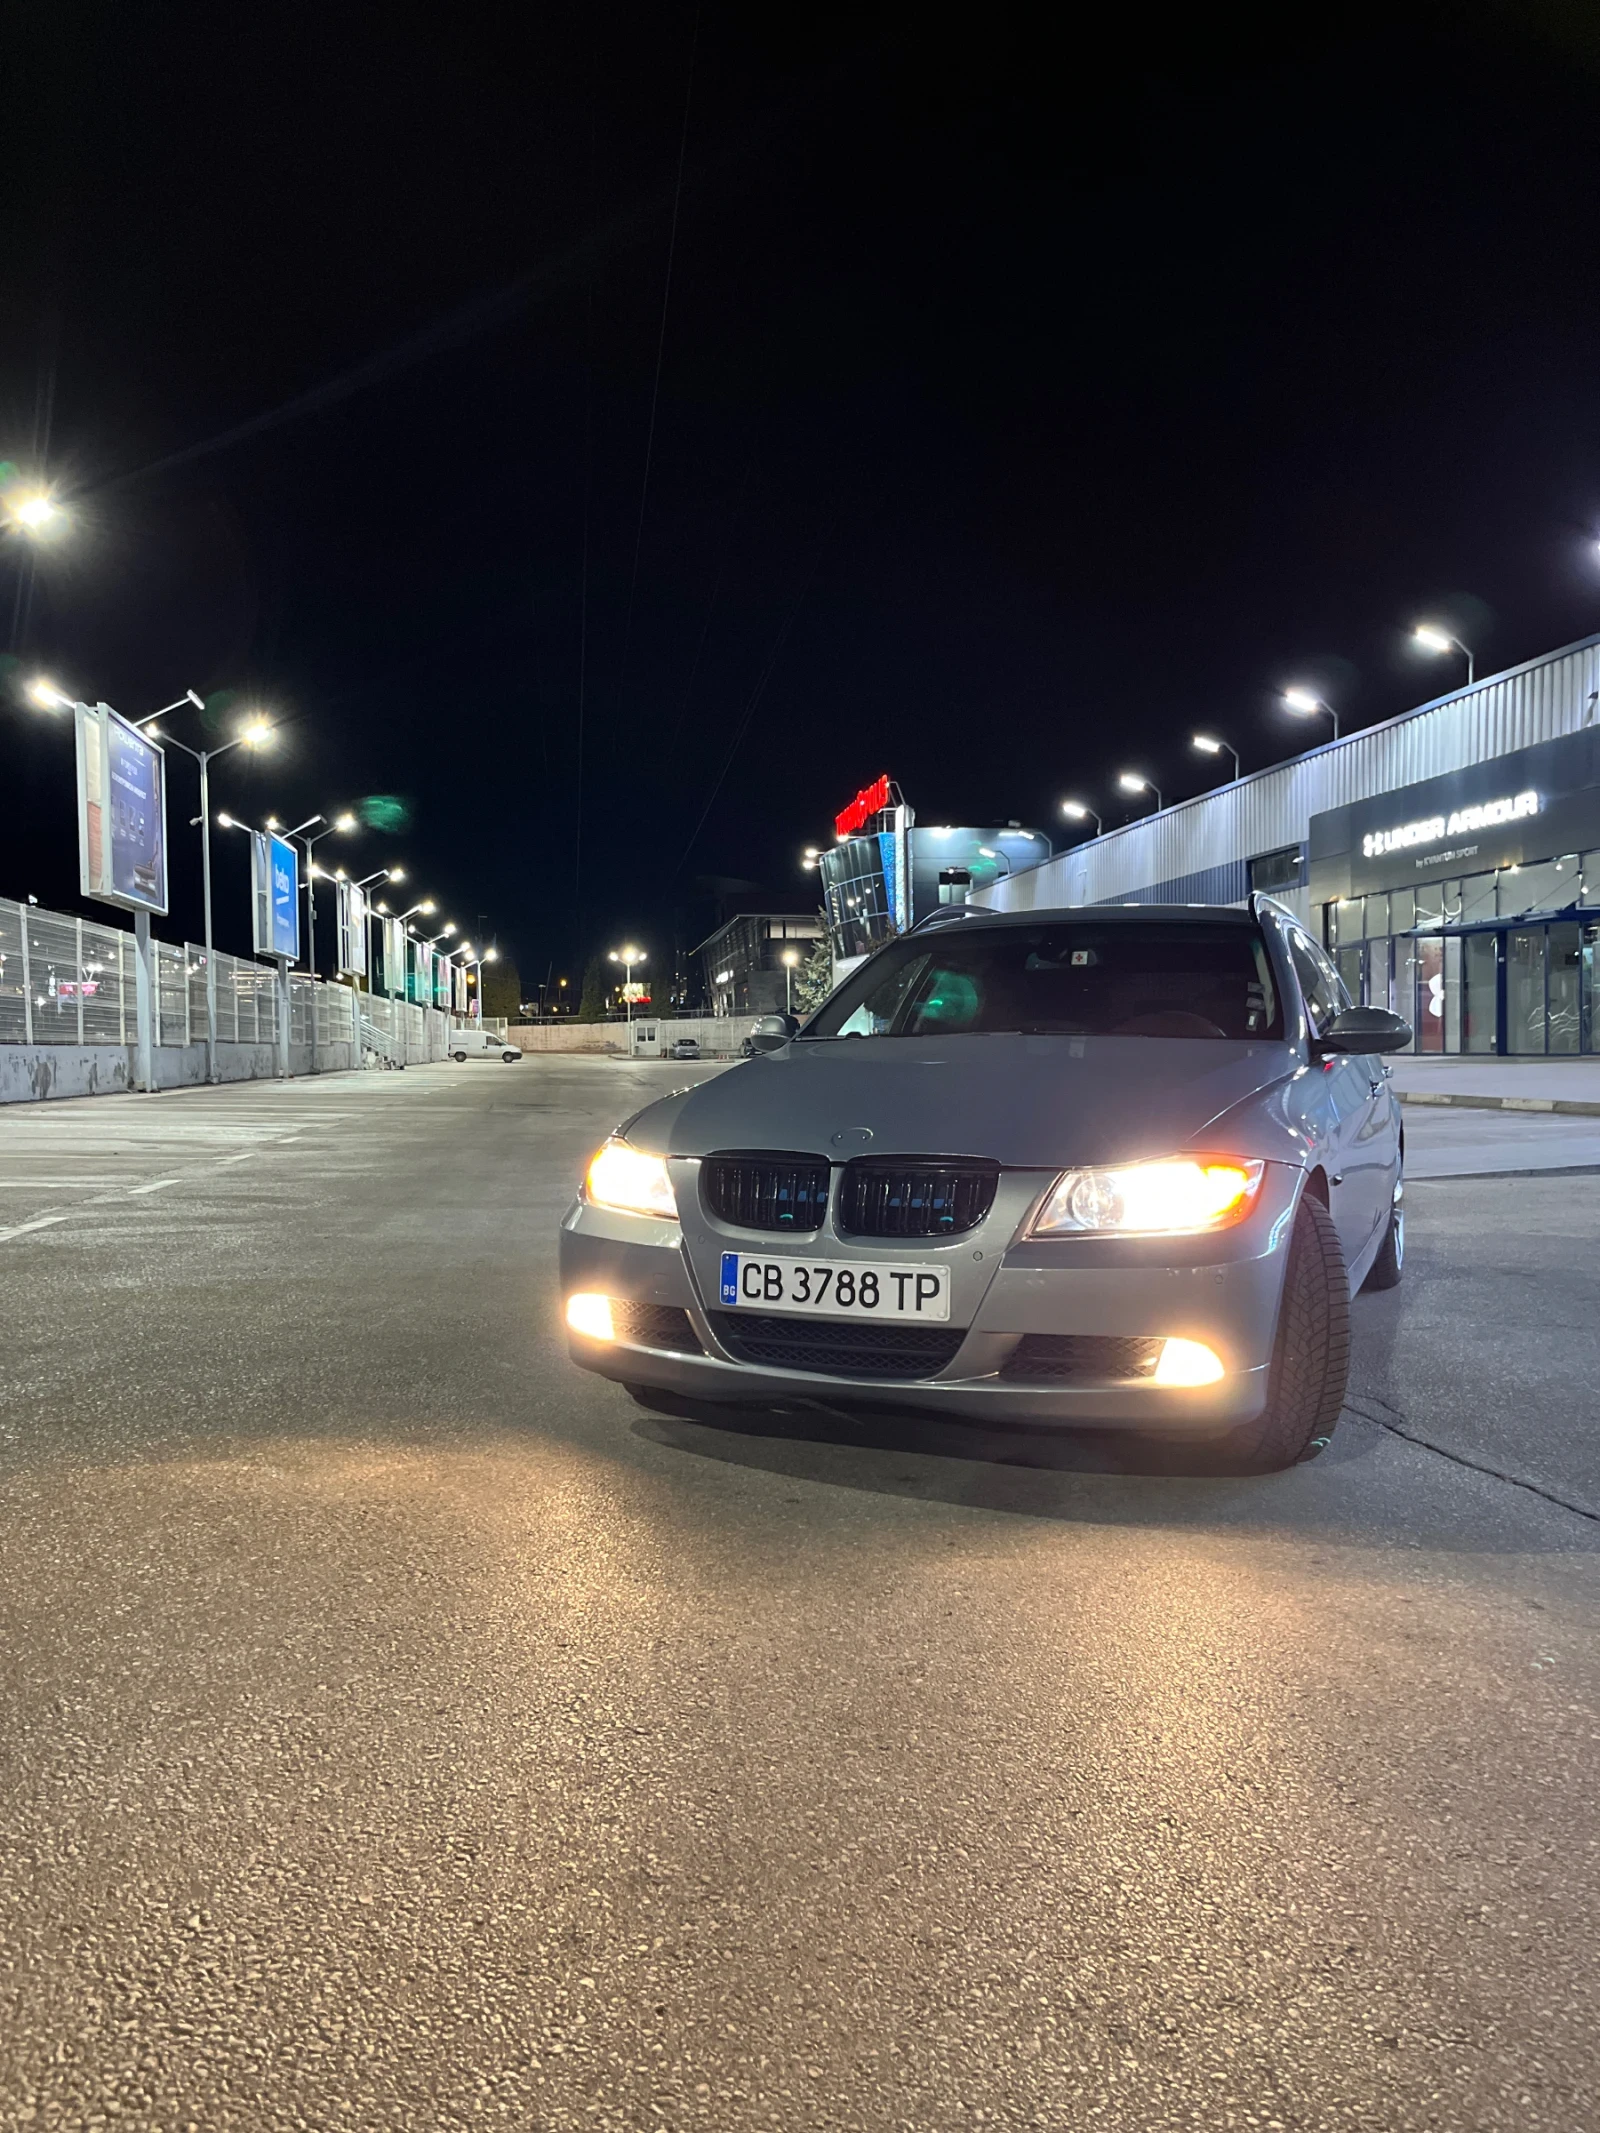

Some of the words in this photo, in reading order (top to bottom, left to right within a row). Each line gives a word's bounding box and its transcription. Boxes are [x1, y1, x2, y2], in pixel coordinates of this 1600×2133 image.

[1384, 816, 1445, 852] UNDER
[1447, 791, 1538, 836] ARMOUR
[1456, 845, 1479, 859] SPORT
[722, 1284, 736, 1296] BG
[742, 1263, 784, 1301] CB
[791, 1266, 880, 1309] 3788
[890, 1271, 941, 1312] TP
